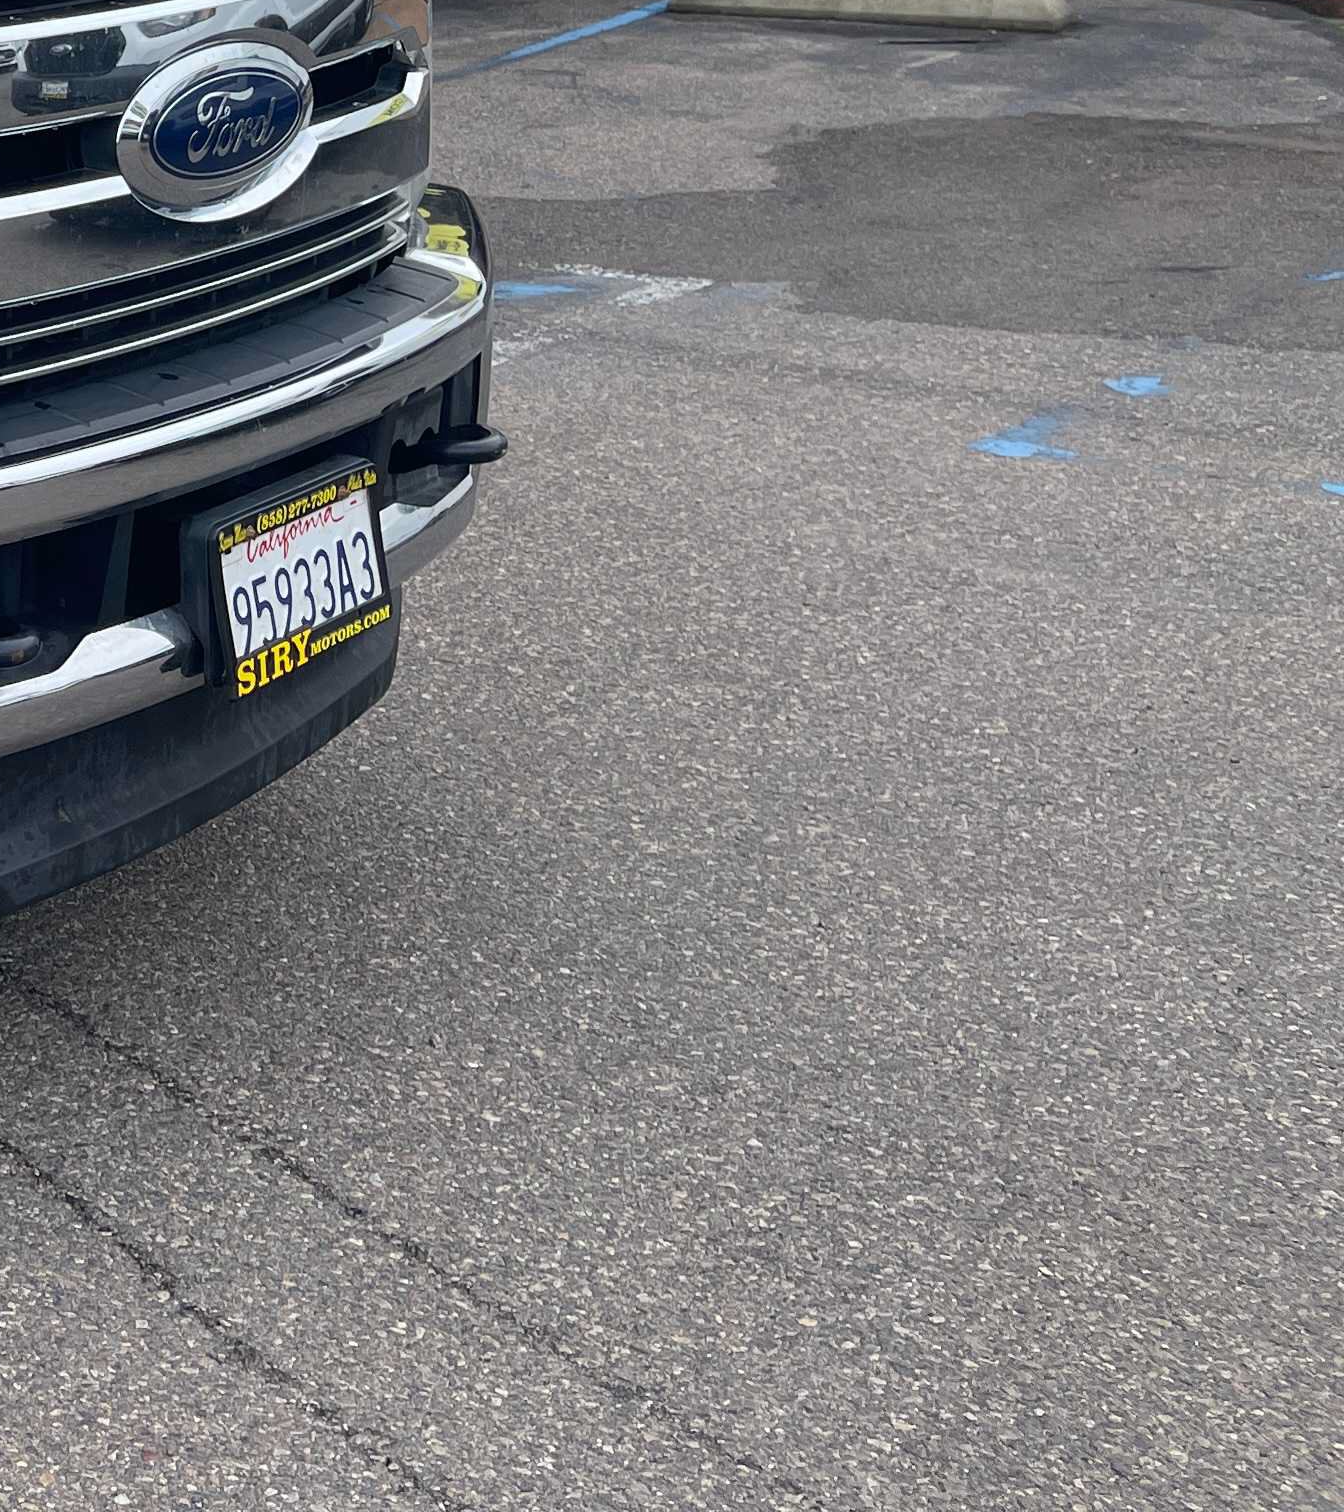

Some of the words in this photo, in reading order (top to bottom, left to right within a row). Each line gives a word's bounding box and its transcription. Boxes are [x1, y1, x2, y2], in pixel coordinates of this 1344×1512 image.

[189, 86, 276, 164] Ford
[247, 505, 344, 563] California
[257, 506, 287, 534] (858)
[289, 485, 336, 519] 277-7300
[233, 532, 375, 658] 95933A3
[237, 628, 312, 697] SIRY
[311, 605, 390, 657] MOTORS.COM
